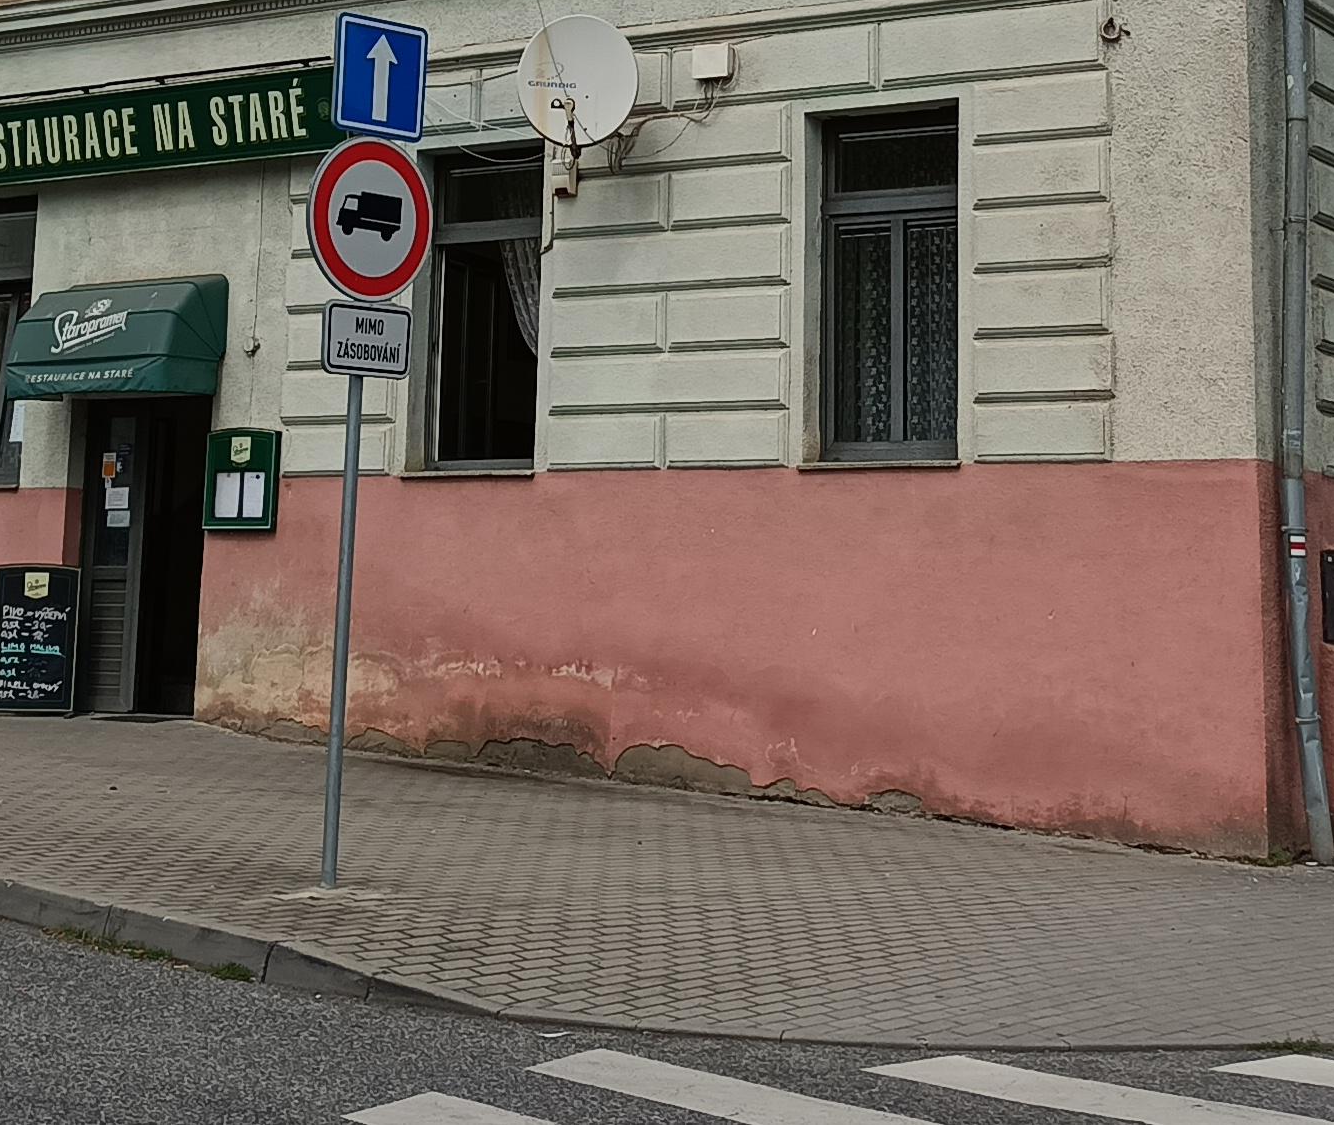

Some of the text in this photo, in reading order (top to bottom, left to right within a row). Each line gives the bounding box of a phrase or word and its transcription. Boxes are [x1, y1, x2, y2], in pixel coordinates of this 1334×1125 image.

[527, 79, 578, 89] GRUNDIG
[152, 100, 195, 152] NA
[209, 77, 308, 147] STARÉ
[354, 316, 385, 336] MIMO
[336, 337, 402, 364] ZÁSOBOVÁNÍ
[25, 368, 134, 384] RESTAURACE NA STARÉ
[2, 605, 25, 620] PIVO
